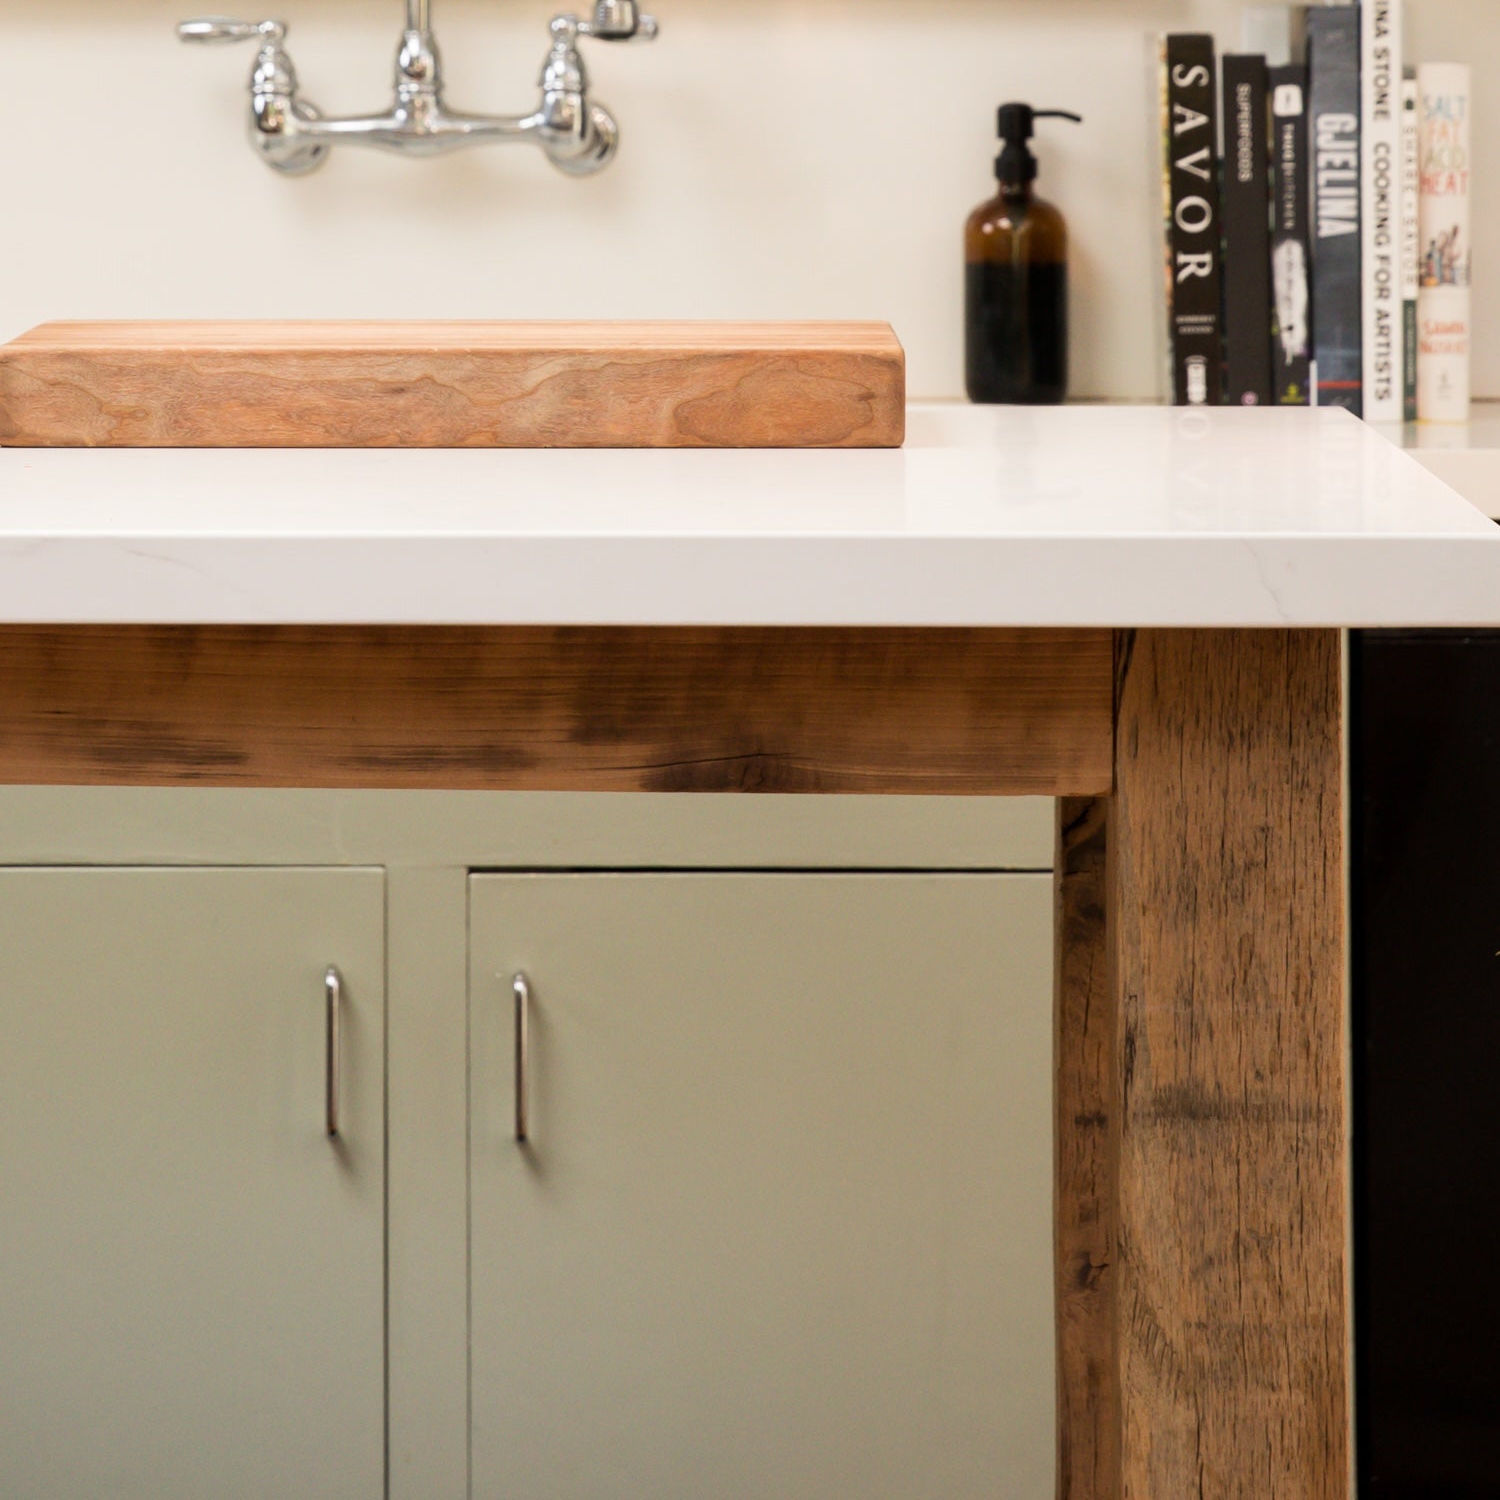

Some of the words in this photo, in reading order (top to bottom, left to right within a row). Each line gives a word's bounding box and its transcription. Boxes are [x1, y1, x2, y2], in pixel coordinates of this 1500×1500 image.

[1236, 83, 1253, 182] SUPERFOODS
[1374, 47, 1390, 121] STONE
[1172, 63, 1213, 284] SAVOR
[1316, 112, 1358, 239] GJELINA
[1374, 141, 1390, 247] COOKING
[1375, 253, 1390, 300] FOR
[1375, 308, 1391, 401] ARTISTS
